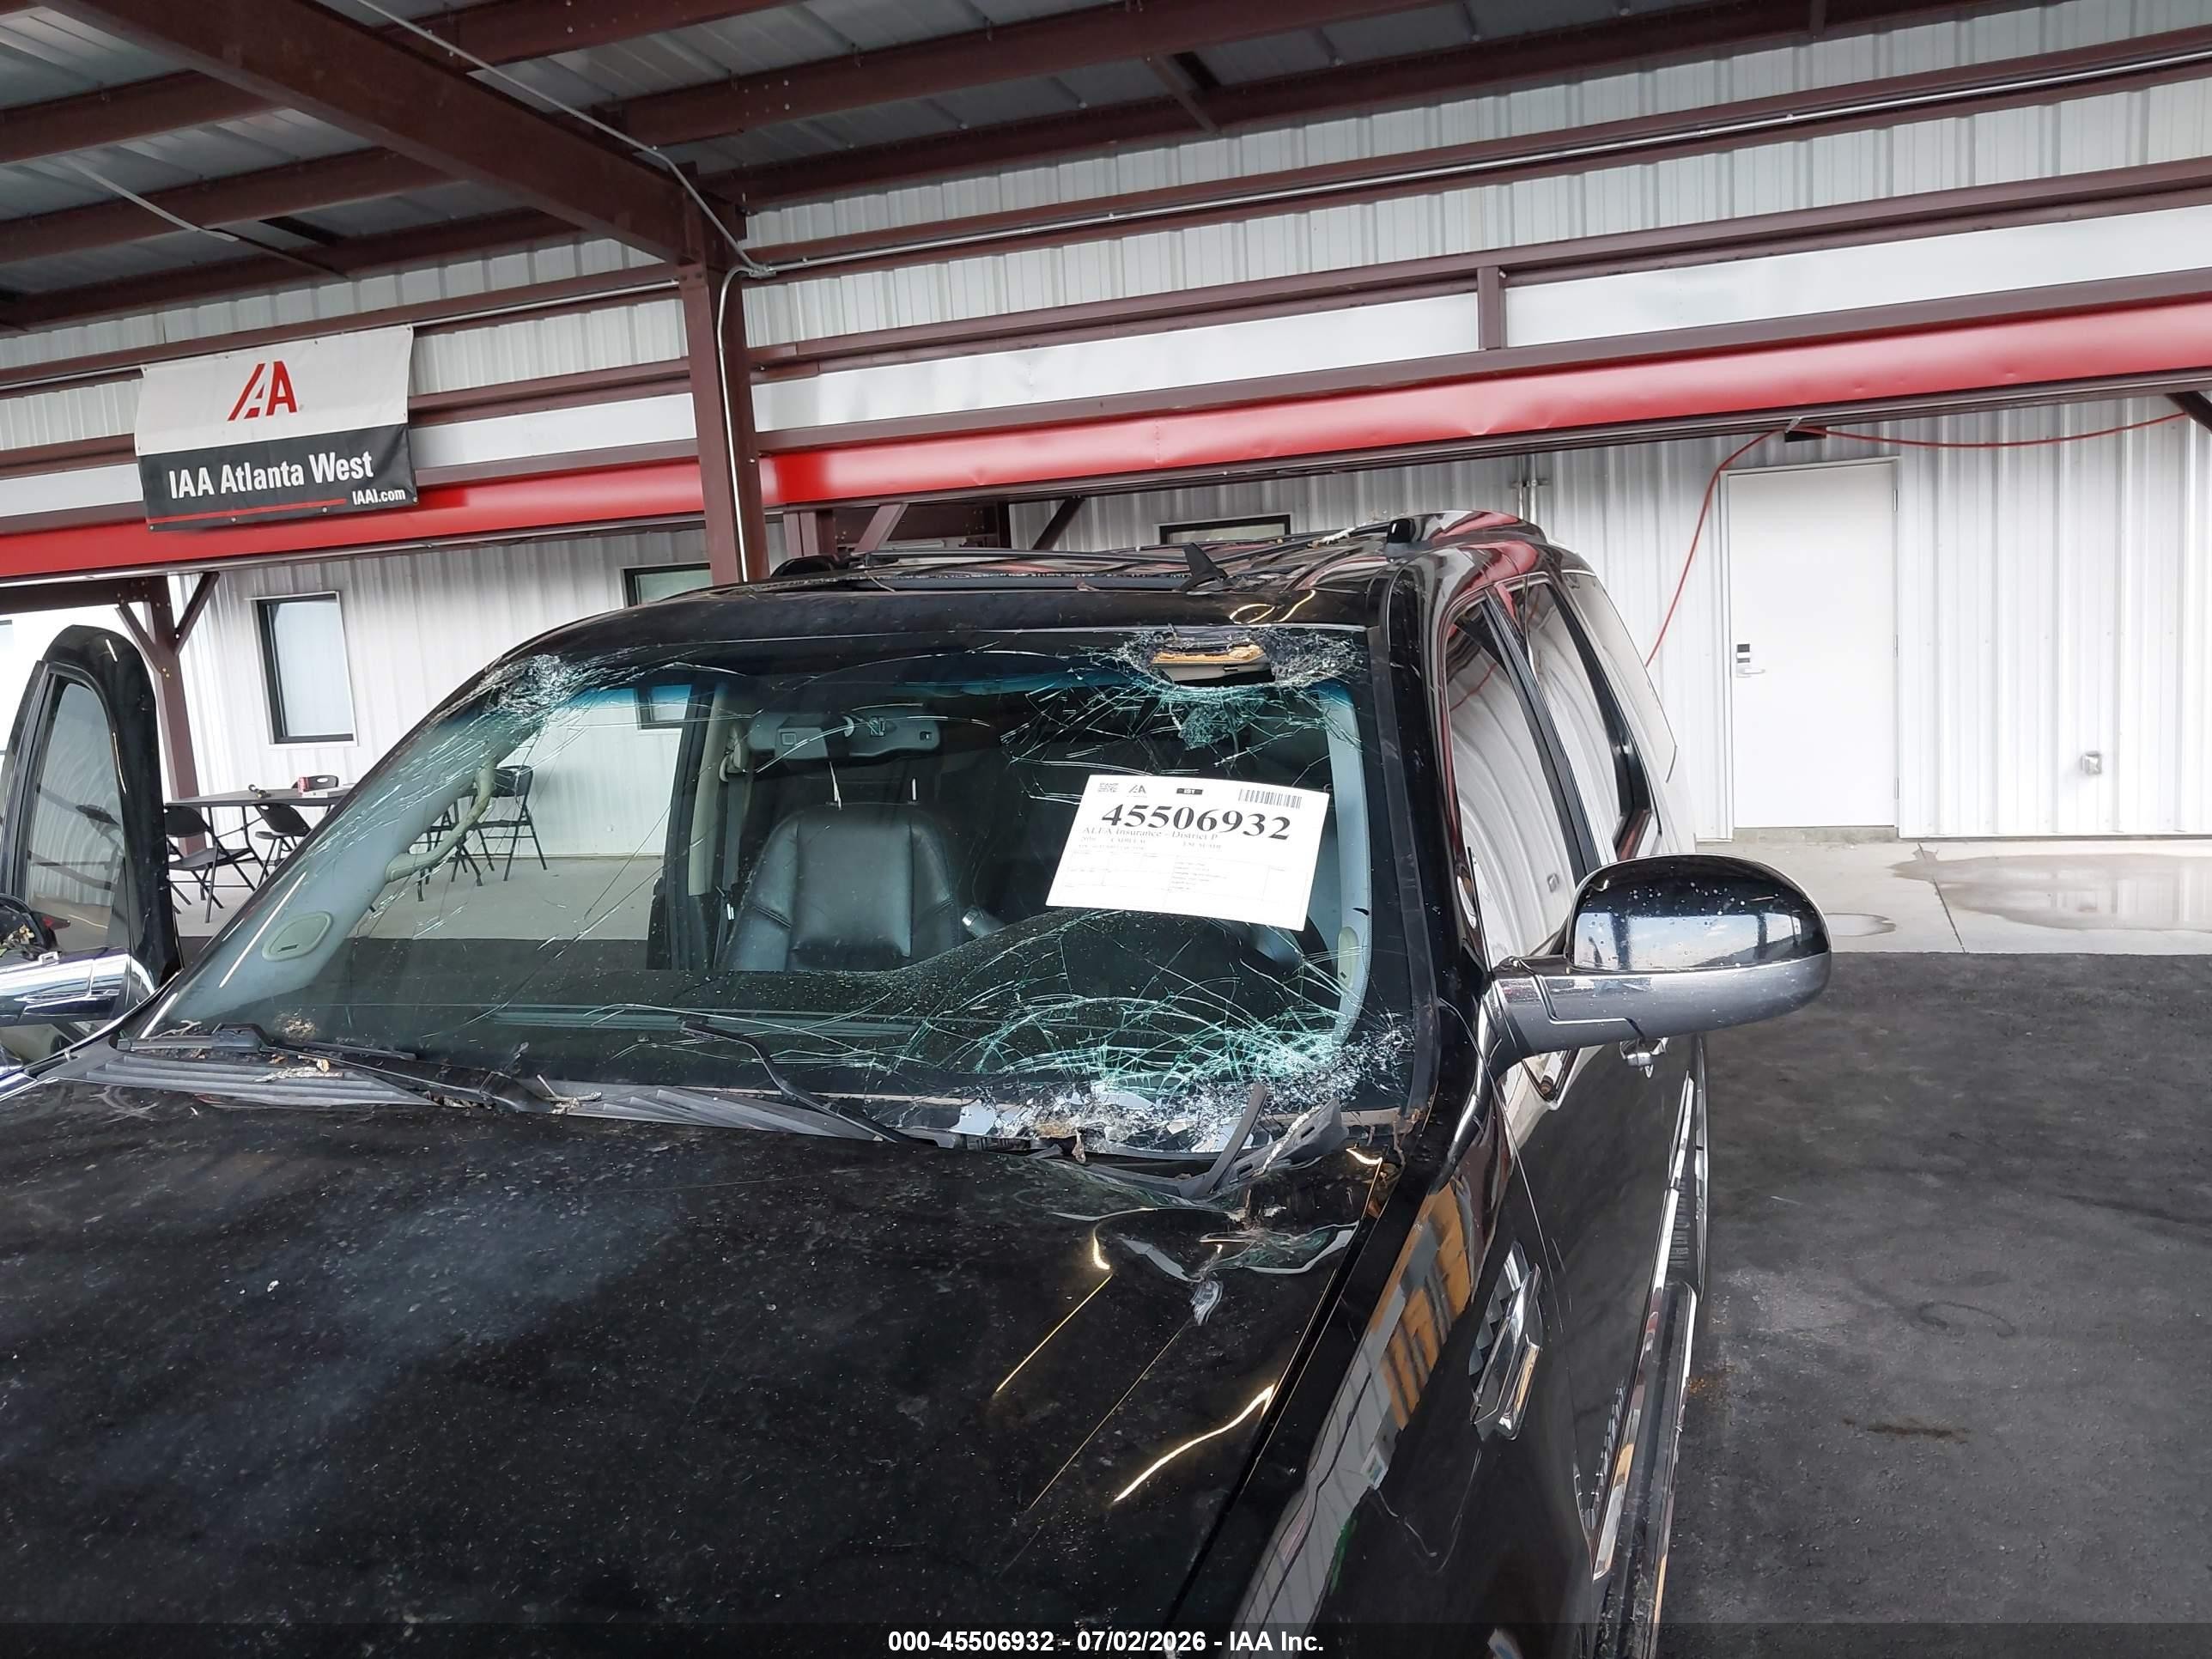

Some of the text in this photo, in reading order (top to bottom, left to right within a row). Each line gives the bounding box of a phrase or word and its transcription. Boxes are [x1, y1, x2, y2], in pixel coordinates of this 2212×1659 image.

[168, 450, 374, 499] IAA Atlanta West
[352, 488, 406, 506] IAAI.com
[1101, 804, 1291, 841] 45506932
[1115, 828, 1163, 838] Insurance
[1171, 830, 1208, 840] District
